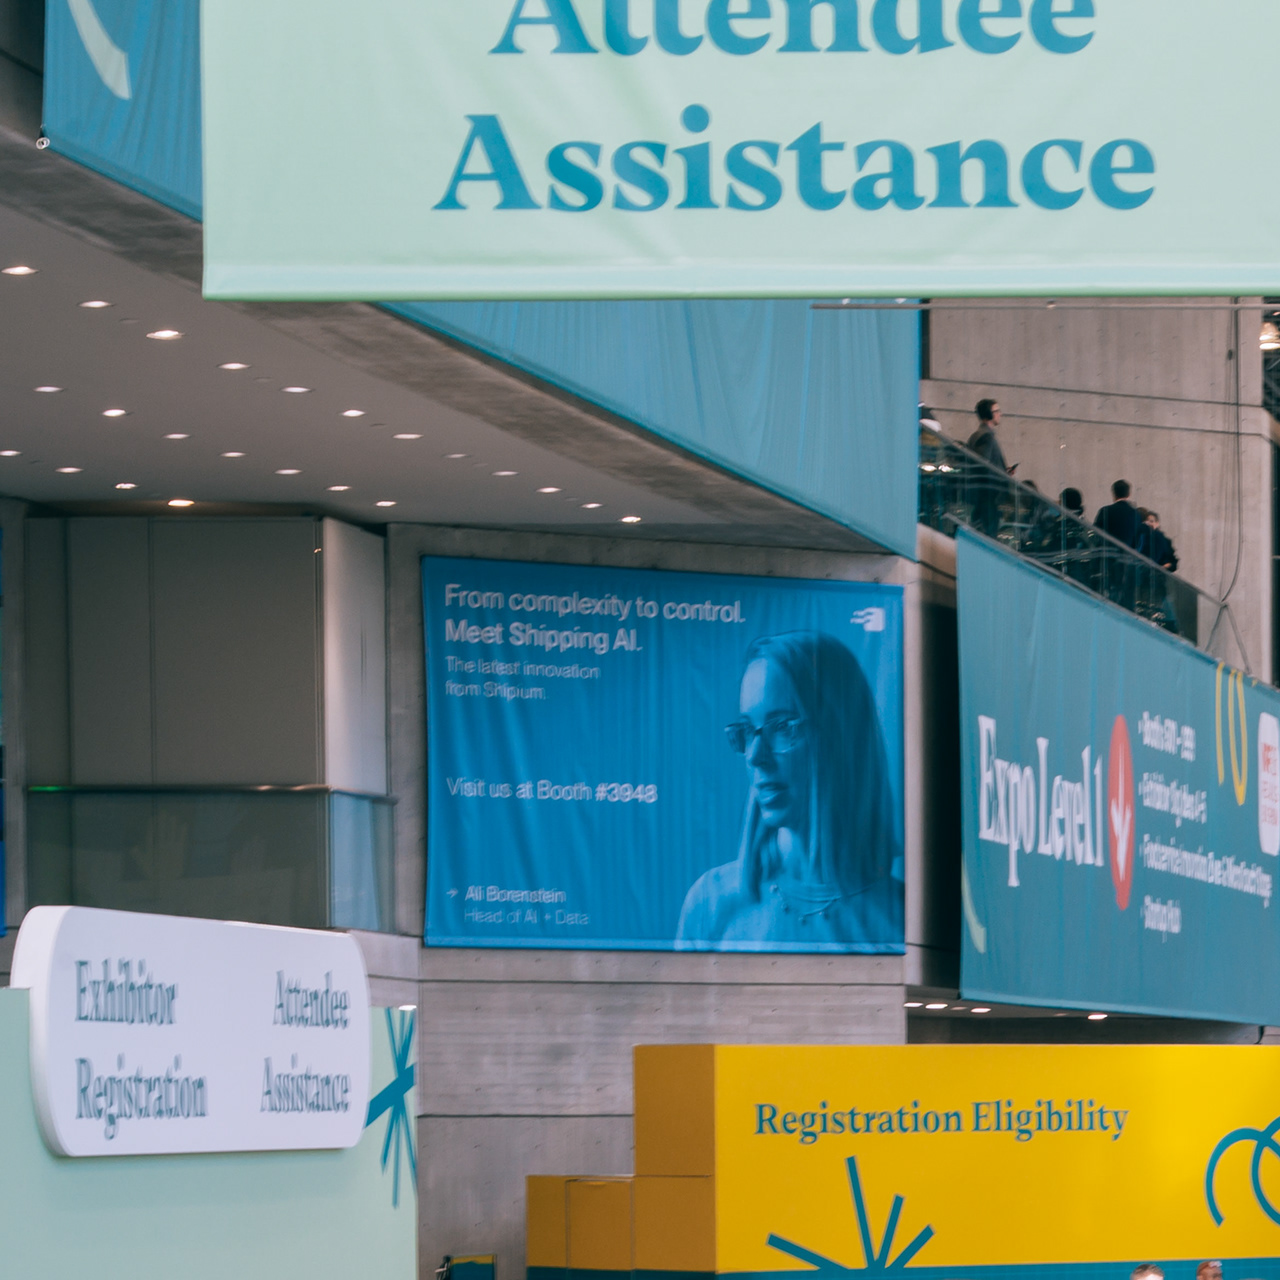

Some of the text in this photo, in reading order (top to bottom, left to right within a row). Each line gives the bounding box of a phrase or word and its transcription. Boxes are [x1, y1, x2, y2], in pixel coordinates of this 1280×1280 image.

[432, 103, 1157, 213] Assistance
[445, 583, 747, 624] From complexity to control.
[445, 618, 505, 645] Meet
[507, 621, 610, 655] Shipping
[445, 655, 601, 680] The latest innovation
[445, 679, 481, 698] from
[446, 776, 593, 801] Visit us at Booth
[977, 714, 1036, 887] Expo
[1037, 736, 1095, 867] Level
[74, 955, 179, 1026] Exhibitor
[272, 969, 351, 1029] Attendee
[75, 1053, 209, 1140] Registration
[260, 1052, 351, 1115] Assistance
[753, 1098, 1130, 1146] Registration Eligibility
